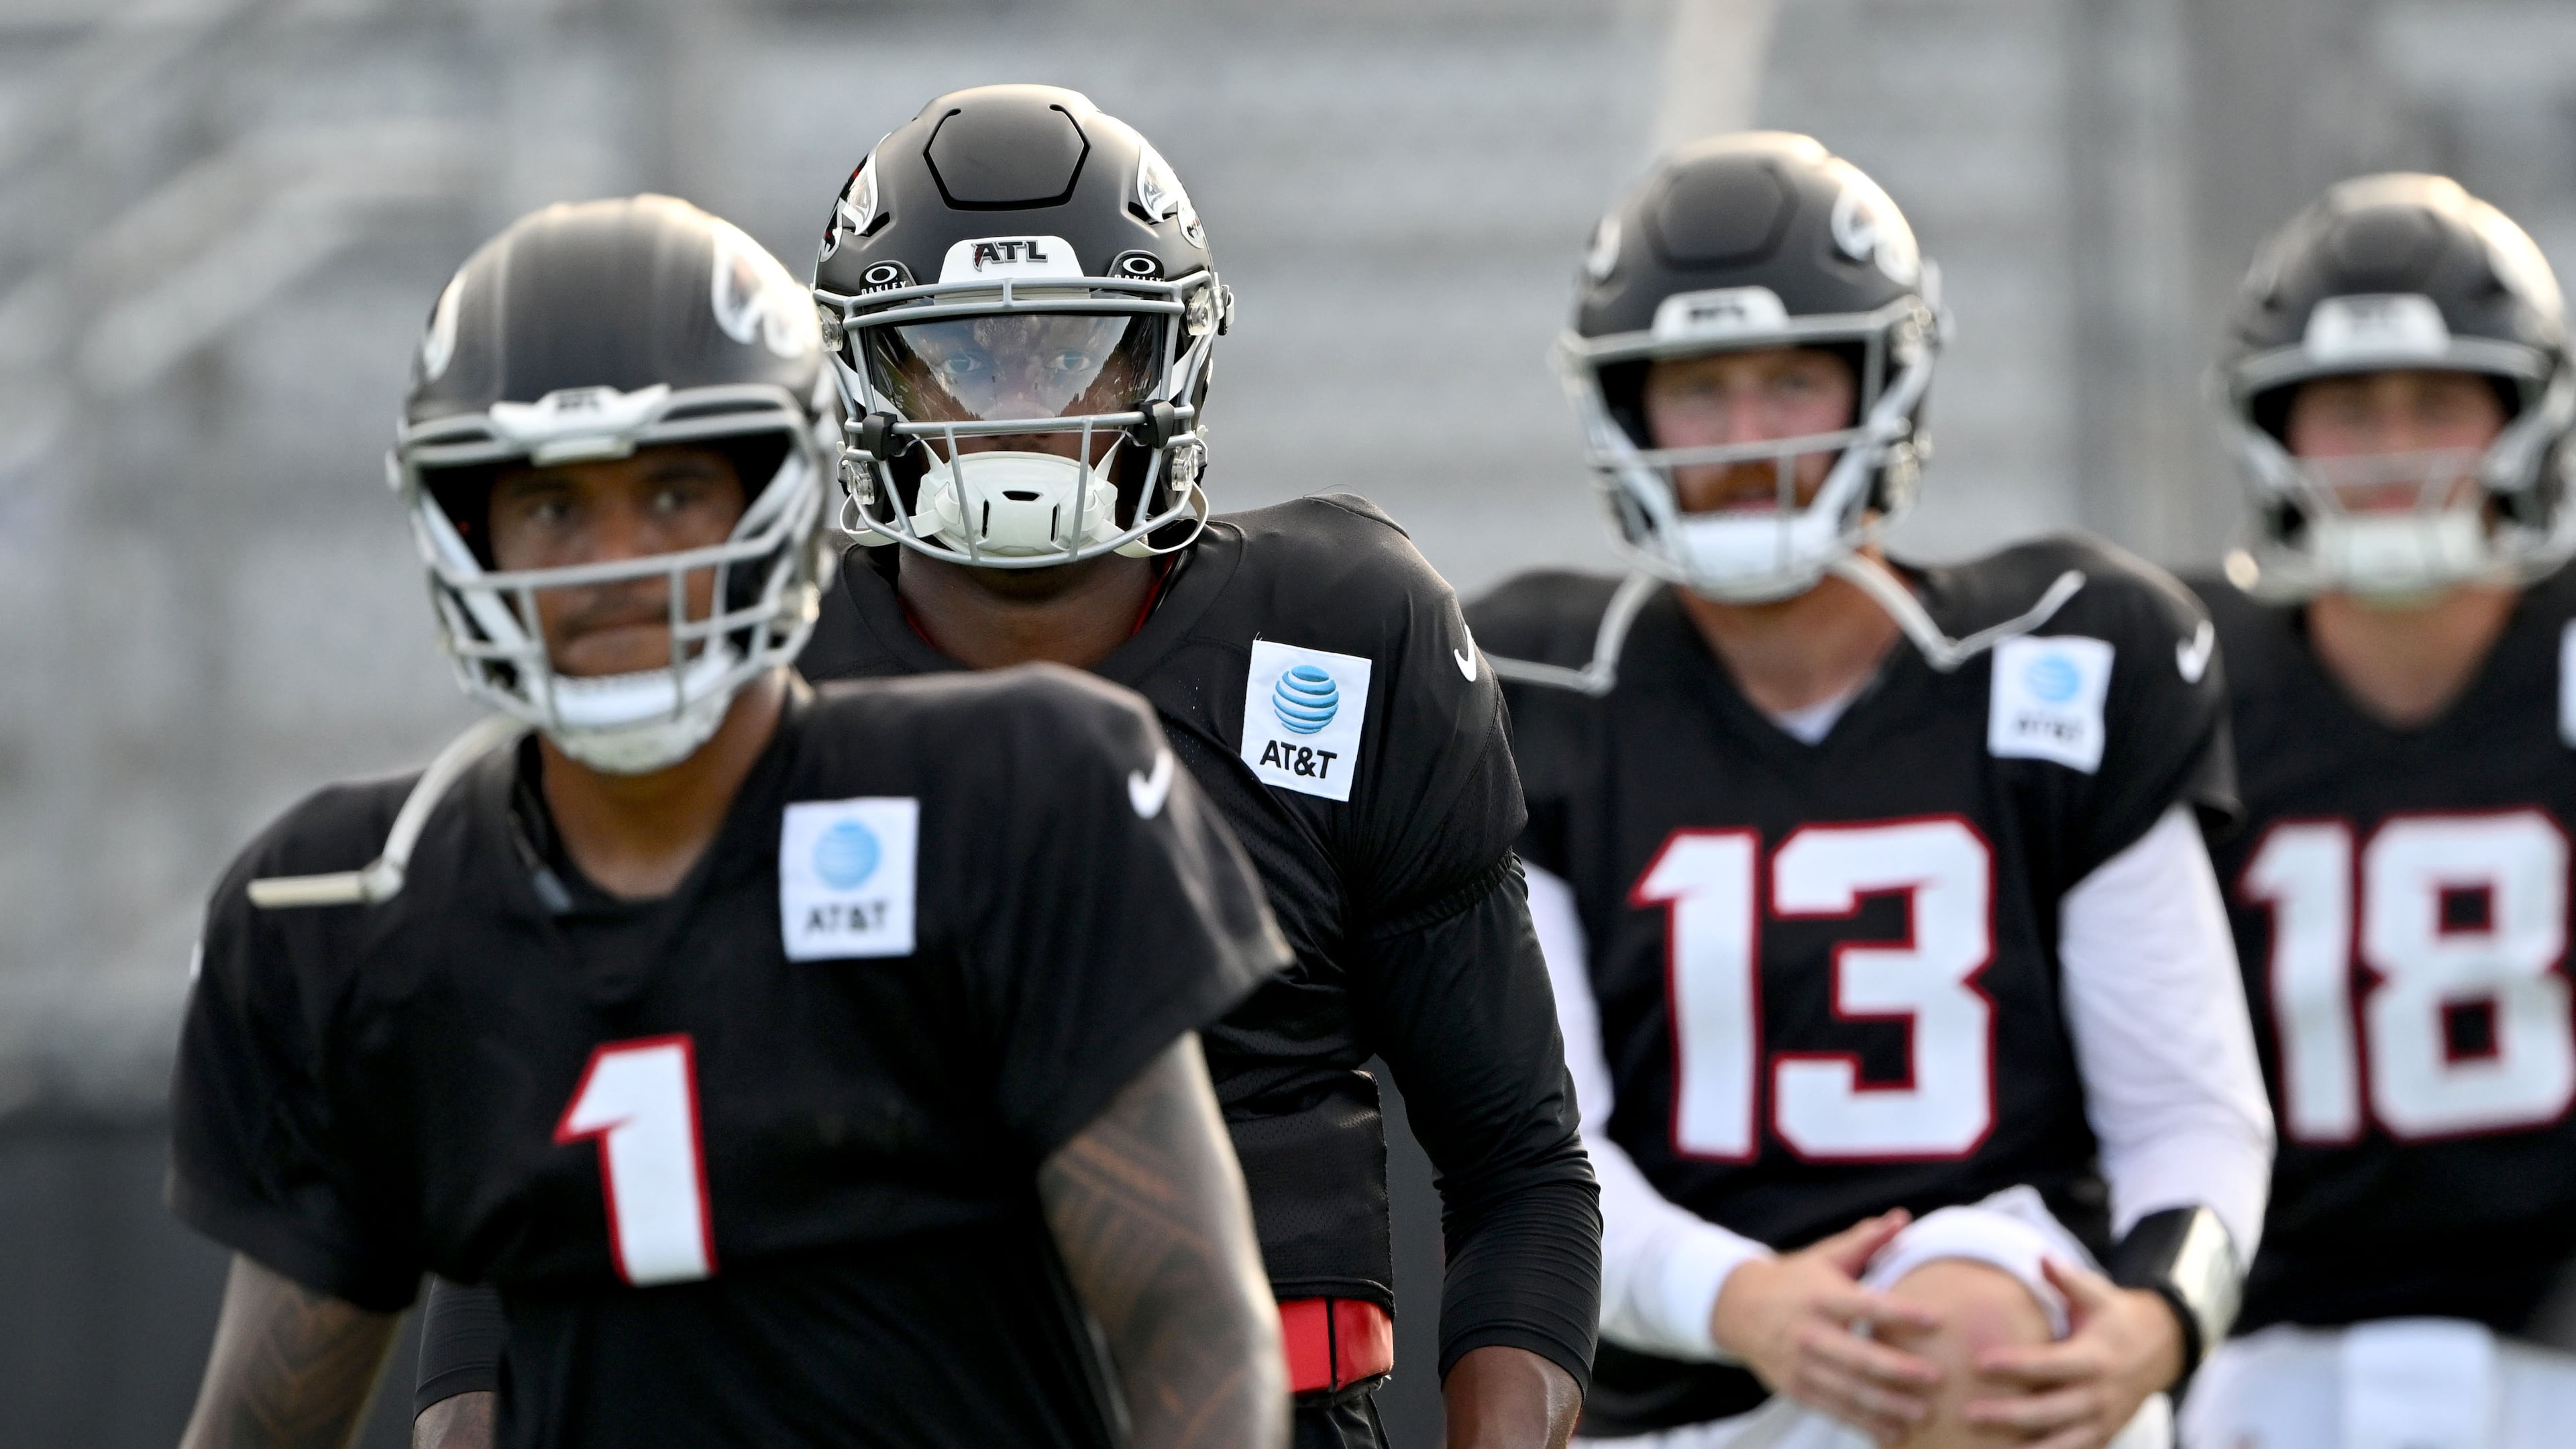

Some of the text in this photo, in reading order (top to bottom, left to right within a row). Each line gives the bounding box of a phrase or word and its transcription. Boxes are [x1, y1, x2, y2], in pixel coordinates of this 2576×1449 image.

[861, 280, 906, 295] OAKLEY
[971, 239, 1048, 272] ATL
[1259, 739, 1338, 779] AT&T
[1627, 812, 1996, 1164] 13
[2235, 803, 2576, 1143] 18
[553, 1032, 720, 1288] 1
